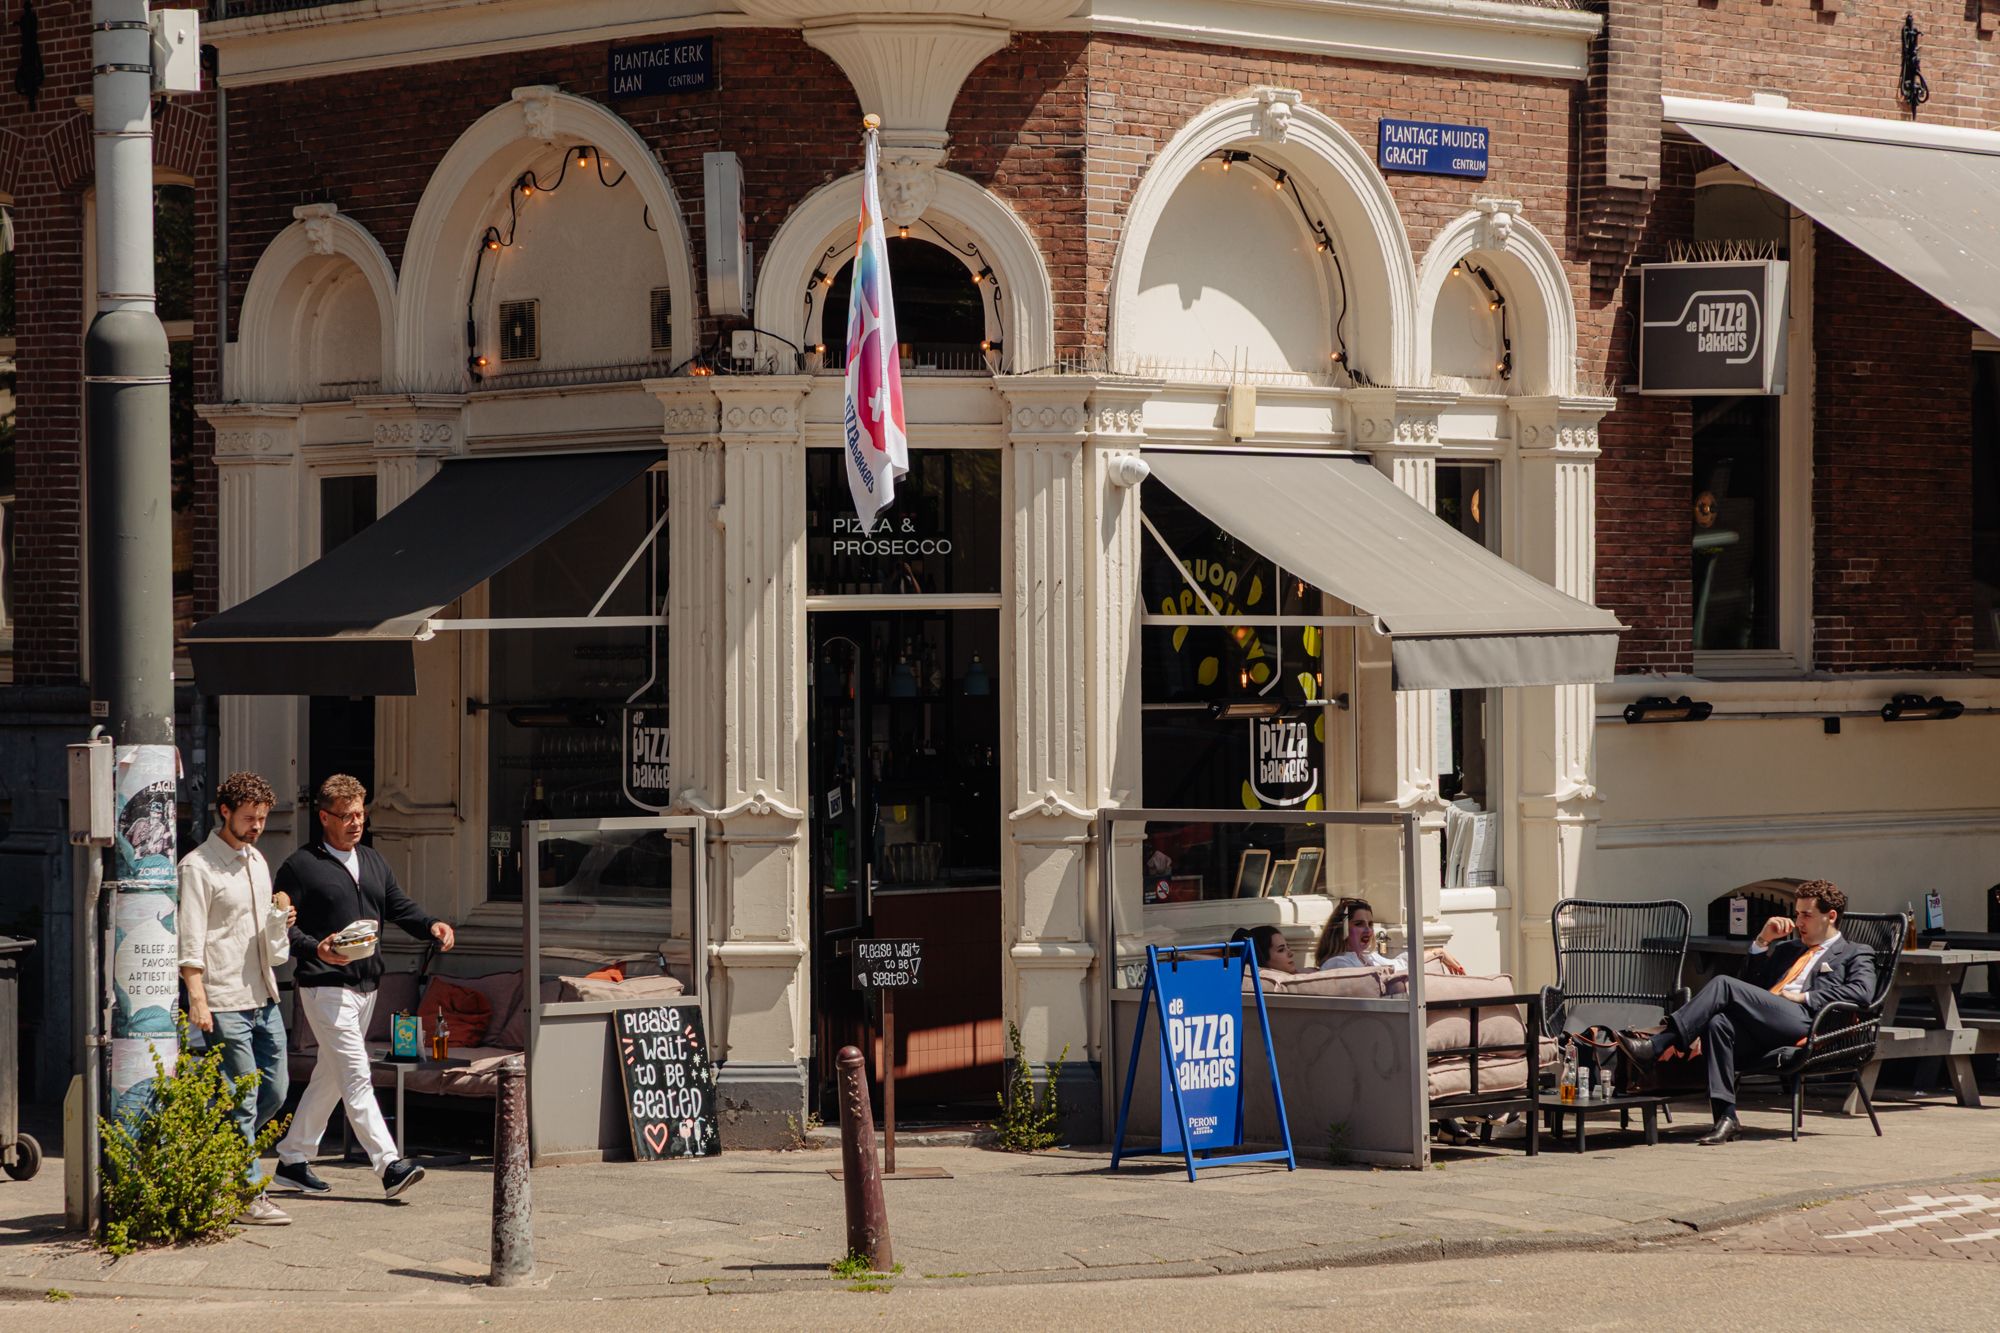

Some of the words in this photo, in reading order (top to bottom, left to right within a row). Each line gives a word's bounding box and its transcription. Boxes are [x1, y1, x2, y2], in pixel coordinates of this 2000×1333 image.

[614, 48, 670, 71] PLANTAGE
[674, 44, 704, 64] KERK
[614, 74, 642, 94] LAAN
[668, 73, 704, 87] CENTRUM
[1385, 125, 1438, 146] PLANTAGE
[1441, 130, 1486, 150] MUIDER
[1385, 146, 1428, 166] GRACHT
[1452, 158, 1486, 171] CENTRUM
[1686, 321, 1697, 332] de
[1698, 302, 1748, 332] pizza
[1698, 332, 1747, 352] bakkers
[901, 517, 916, 533] &
[833, 539, 952, 555] PROSECCO
[633, 711, 644, 725] de
[632, 727, 670, 763] pizz
[1260, 722, 1308, 759] pizza
[632, 764, 670, 789] bakke
[1260, 758, 1309, 783] bakkers
[134, 944, 165, 954] BELEEF
[128, 971, 166, 982] ARTIEST
[128, 985, 141, 995] DE
[1168, 998, 1184, 1015] de
[1168, 1013, 1235, 1062] pizza
[638, 1035, 687, 1061] wait
[634, 1064, 657, 1086] to
[1188, 1116, 1218, 1128] PERONI
